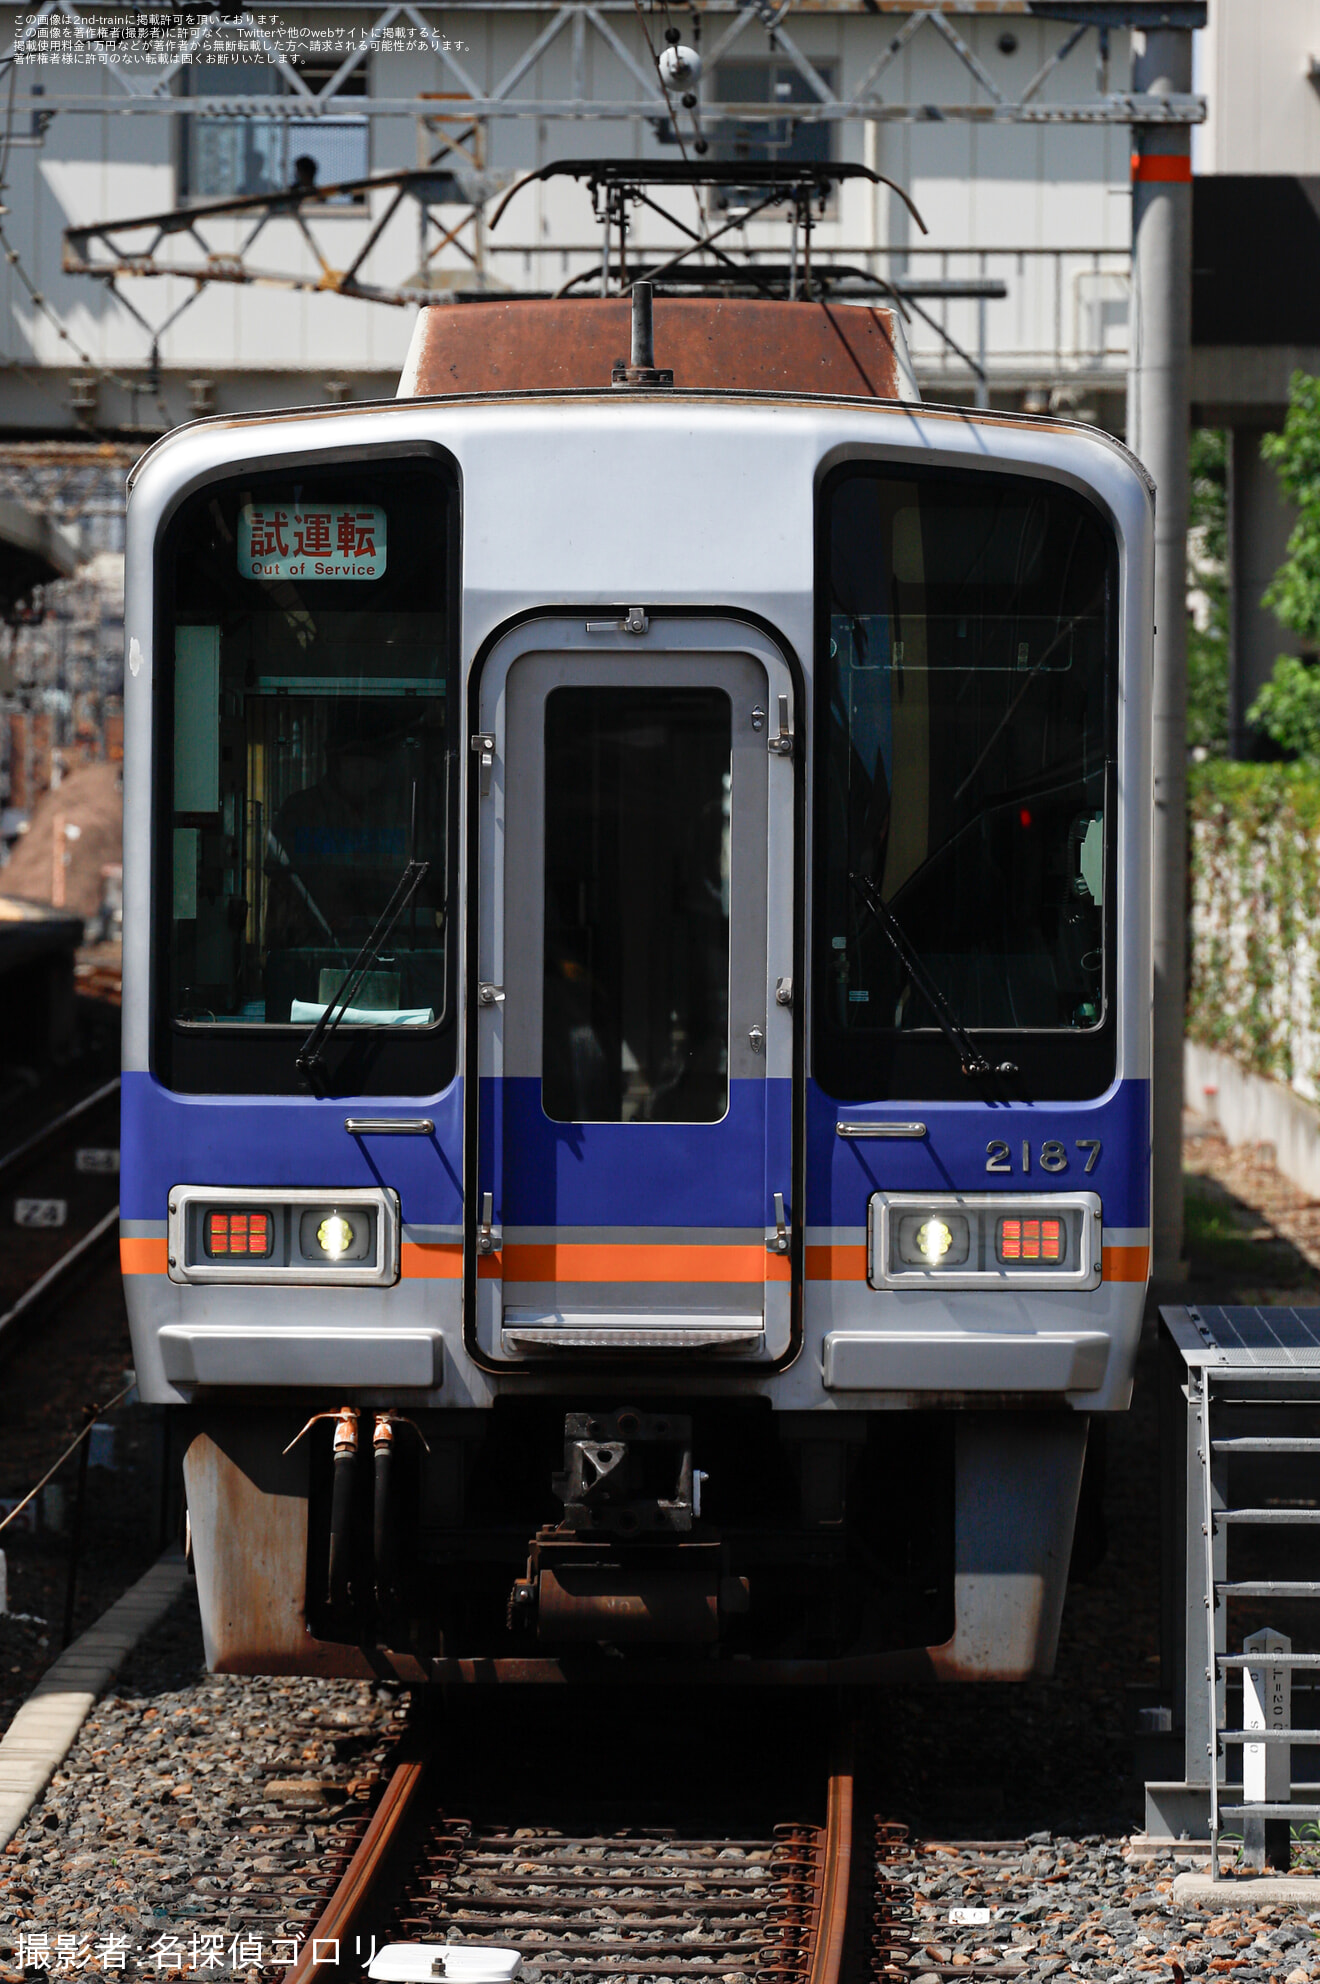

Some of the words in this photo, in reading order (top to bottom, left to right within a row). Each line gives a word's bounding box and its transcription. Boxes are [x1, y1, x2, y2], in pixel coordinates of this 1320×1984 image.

[251, 512, 376, 557] 試運転
[251, 562, 280, 575] Out
[289, 562, 305, 575] of
[314, 562, 375, 575] Service
[985, 1140, 1101, 1172] 2187
